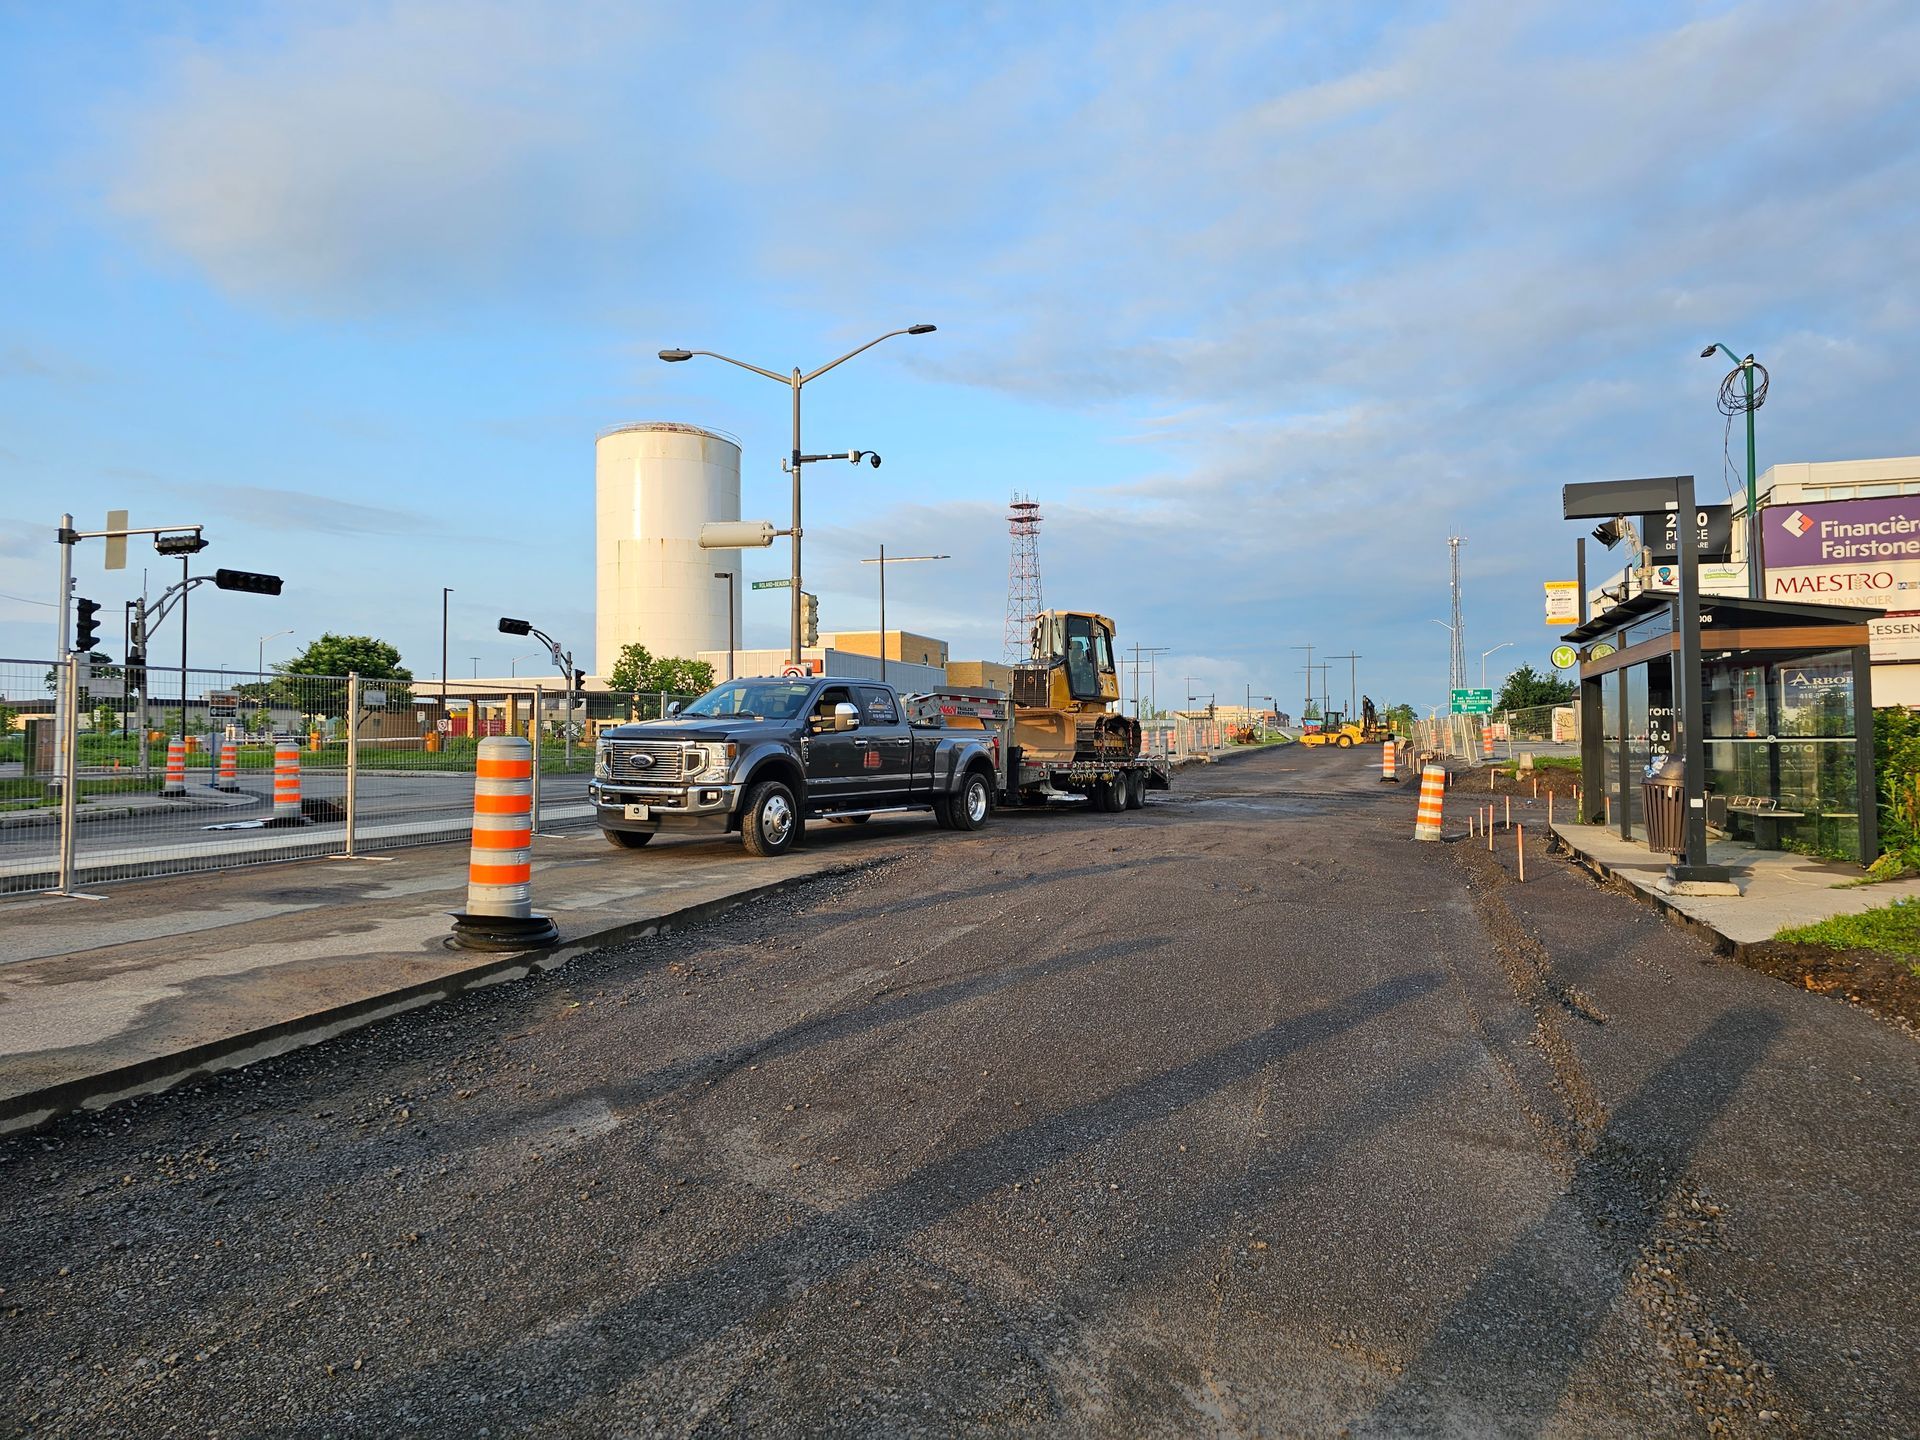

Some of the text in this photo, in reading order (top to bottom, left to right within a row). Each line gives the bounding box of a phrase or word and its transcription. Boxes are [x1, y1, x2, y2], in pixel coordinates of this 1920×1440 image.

[1821, 515, 1920, 538] Financièr
[1821, 540, 1920, 558] Fairstone
[1775, 572, 1893, 594] MAESTRO
[1869, 624, 1920, 635] 'ESSEN
